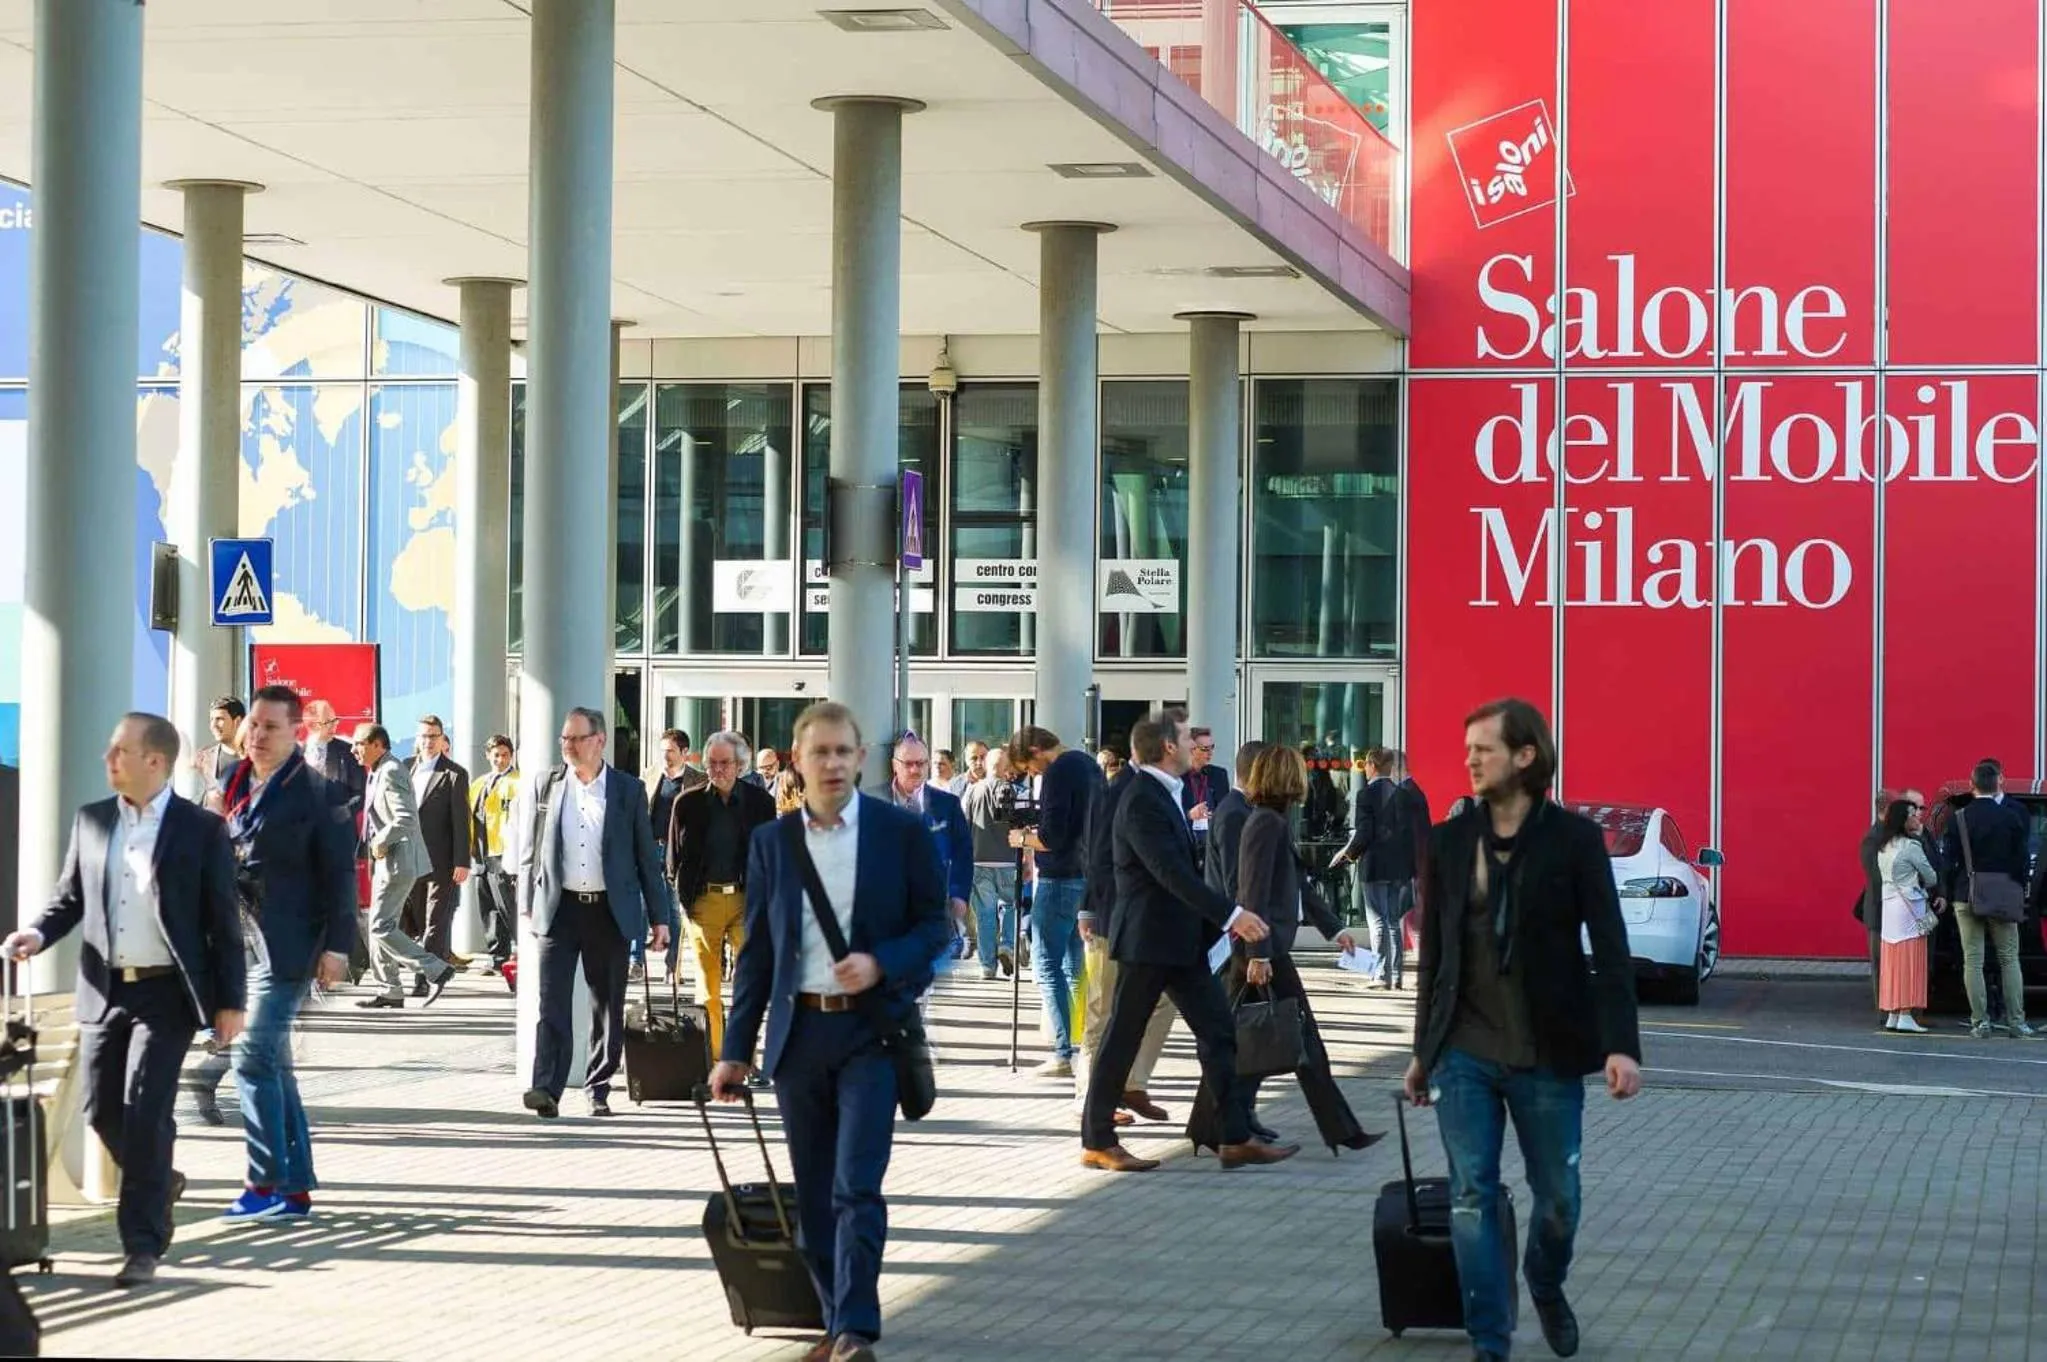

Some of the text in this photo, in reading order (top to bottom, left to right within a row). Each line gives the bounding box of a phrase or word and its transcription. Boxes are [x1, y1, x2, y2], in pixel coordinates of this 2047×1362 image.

[1477, 254, 1848, 360] Salone
[1475, 380, 2038, 485] del Mobile
[1469, 507, 1853, 609] Milano
[976, 564, 1015, 577] centro
[1139, 567, 1171, 577] Stella
[1137, 576, 1172, 586] Polare
[976, 592, 1033, 607] congress
